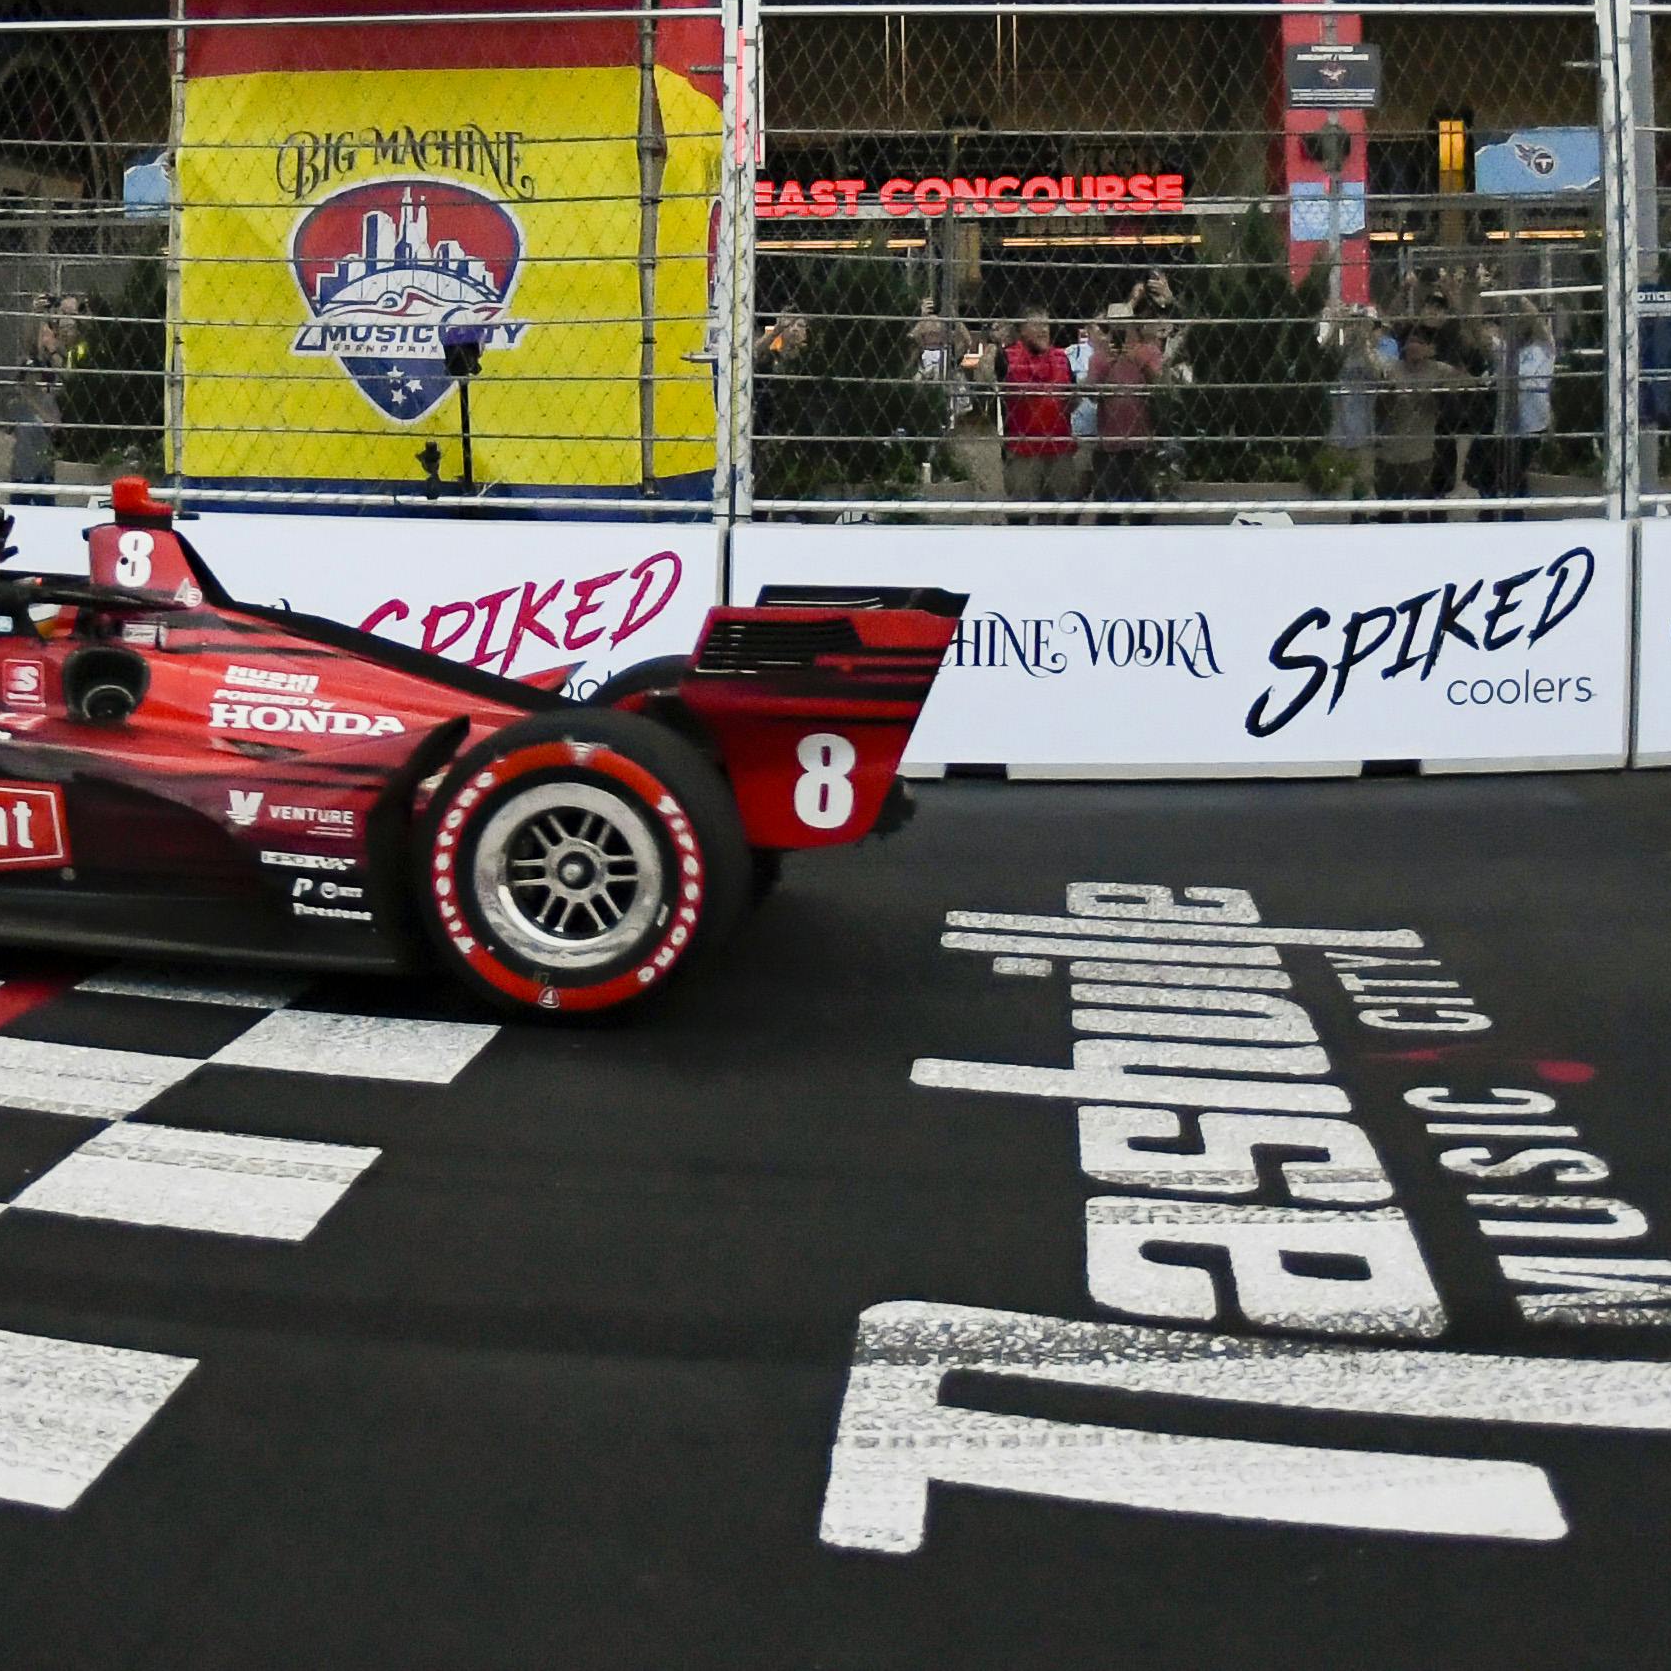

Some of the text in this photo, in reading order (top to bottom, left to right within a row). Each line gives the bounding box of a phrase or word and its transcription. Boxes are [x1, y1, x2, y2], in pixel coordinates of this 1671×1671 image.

[276, 124, 536, 199] BIG MACHINE
[755, 174, 1185, 218] EAST CONCOURSE
[1637, 291, 1671, 302] OTICE
[323, 324, 434, 343] MUSIC
[115, 530, 155, 588] 8
[940, 610, 1225, 678] HINE VODKA
[1245, 546, 1596, 738] SPIKED
[1446, 668, 1596, 706] coolers
[208, 703, 406, 736] HONDA
[791, 733, 856, 829] 8
[268, 805, 354, 825] VENTURE
[1322, 949, 1493, 1032] CITY
